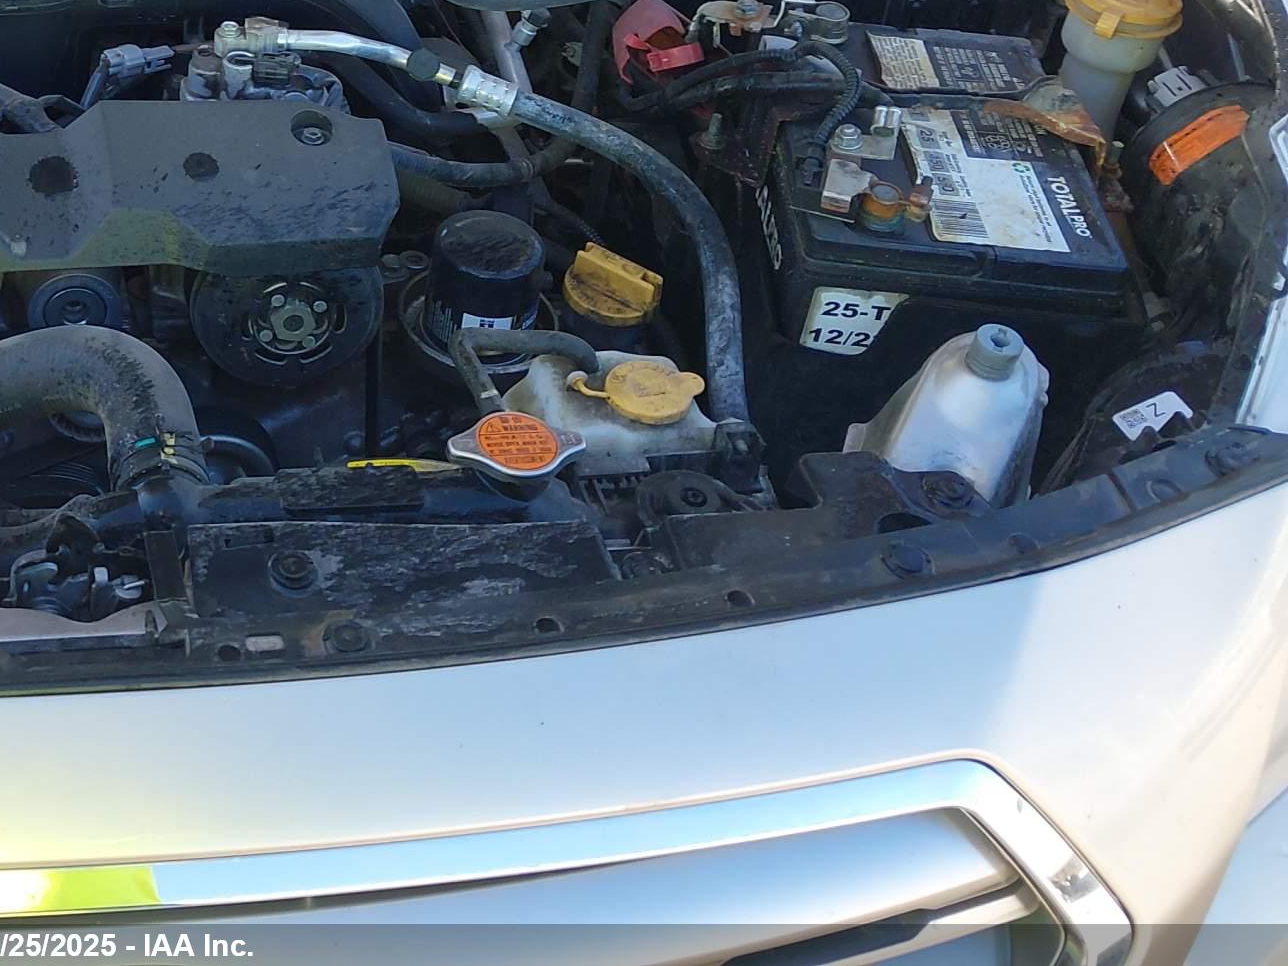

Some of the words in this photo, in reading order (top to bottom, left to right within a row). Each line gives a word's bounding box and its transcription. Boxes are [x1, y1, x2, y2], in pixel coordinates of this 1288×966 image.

[1047, 176, 1091, 238] TOTALPRO
[820, 301, 891, 322] 25-T
[1145, 402, 1167, 418] Z
